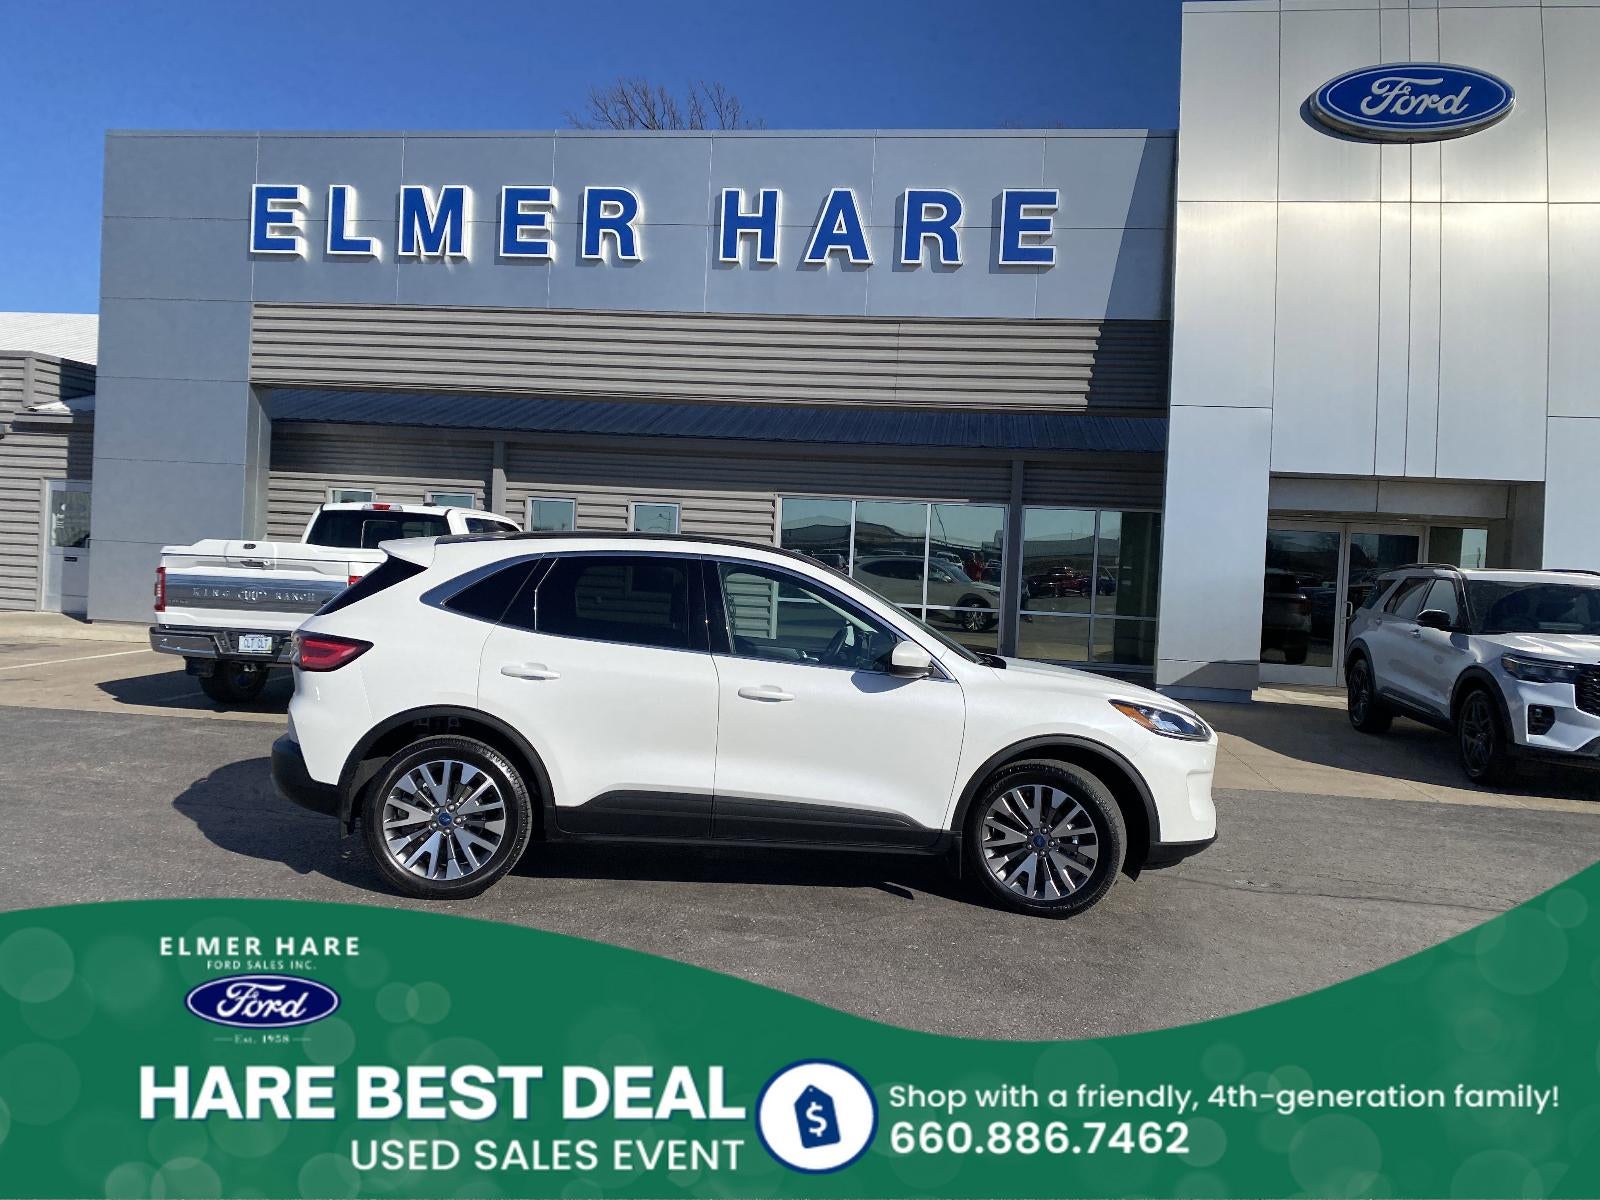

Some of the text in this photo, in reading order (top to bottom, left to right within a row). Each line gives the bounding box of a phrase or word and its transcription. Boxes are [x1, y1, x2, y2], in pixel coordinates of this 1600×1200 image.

[1360, 76, 1472, 116] Ford
[250, 183, 1060, 266] ELMER HARE
